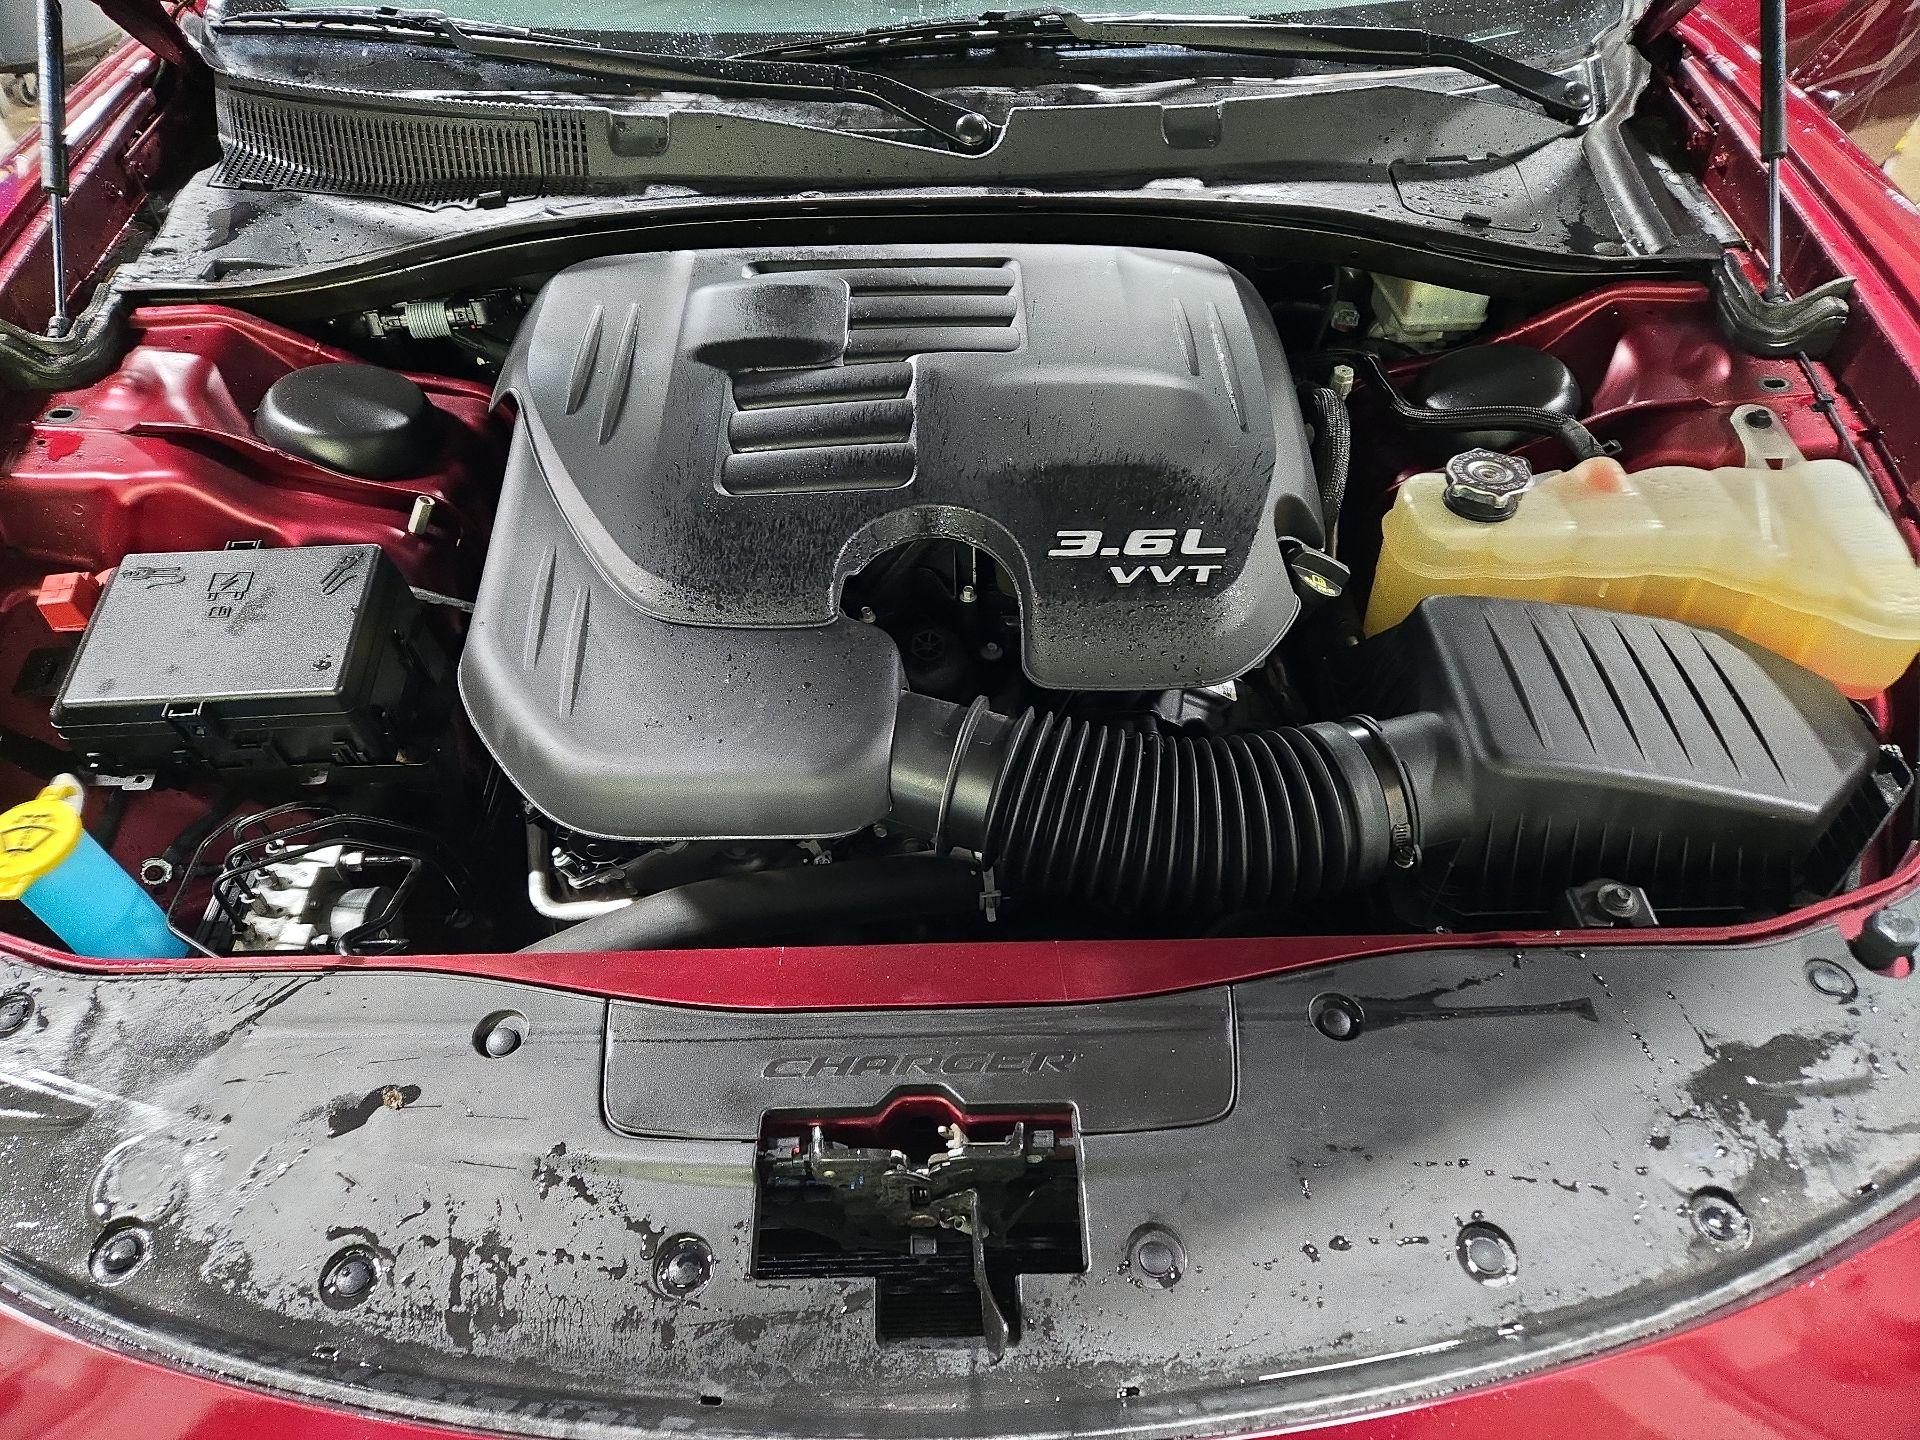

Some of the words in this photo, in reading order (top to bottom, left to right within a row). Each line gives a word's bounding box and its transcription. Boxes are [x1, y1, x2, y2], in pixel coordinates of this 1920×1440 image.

[1047, 528, 1227, 557] 3.6L
[1109, 565, 1223, 586] VVT
[761, 1051, 1078, 1079] CHARGER
